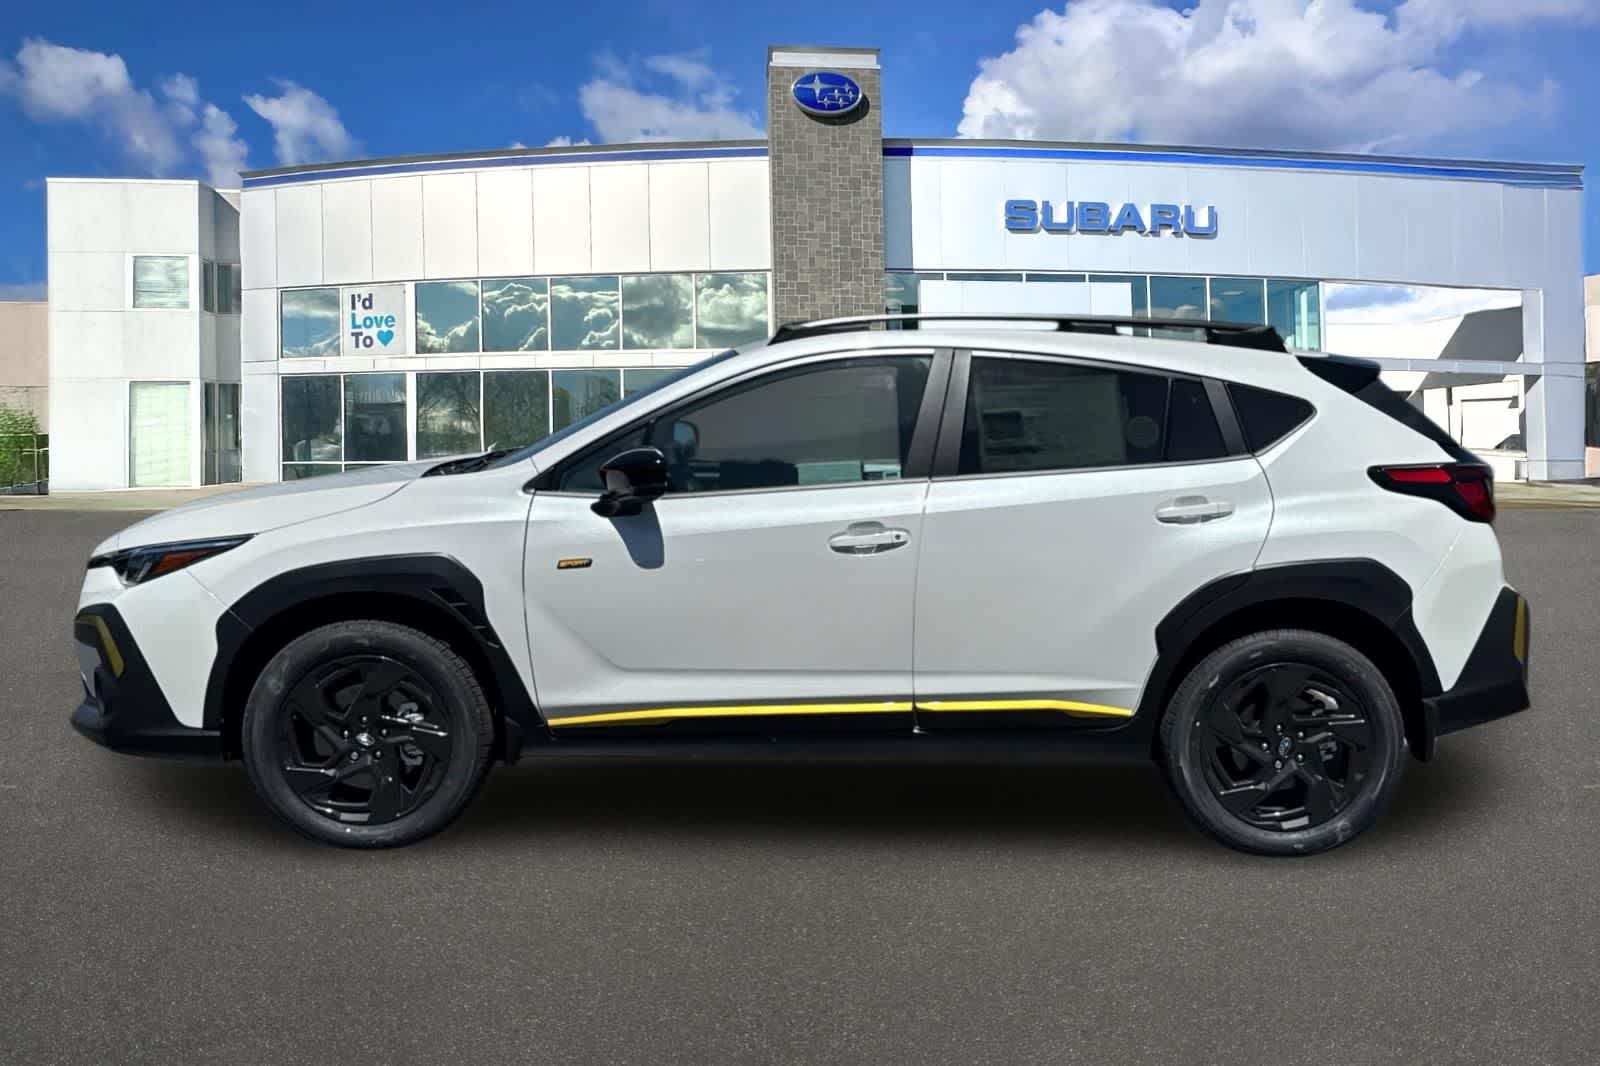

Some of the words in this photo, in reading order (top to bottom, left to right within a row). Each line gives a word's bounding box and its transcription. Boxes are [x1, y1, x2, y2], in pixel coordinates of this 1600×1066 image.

[1004, 199, 1218, 238] SUBARU
[351, 293, 373, 310] I'd
[351, 312, 396, 329] Love
[351, 331, 374, 348] To
